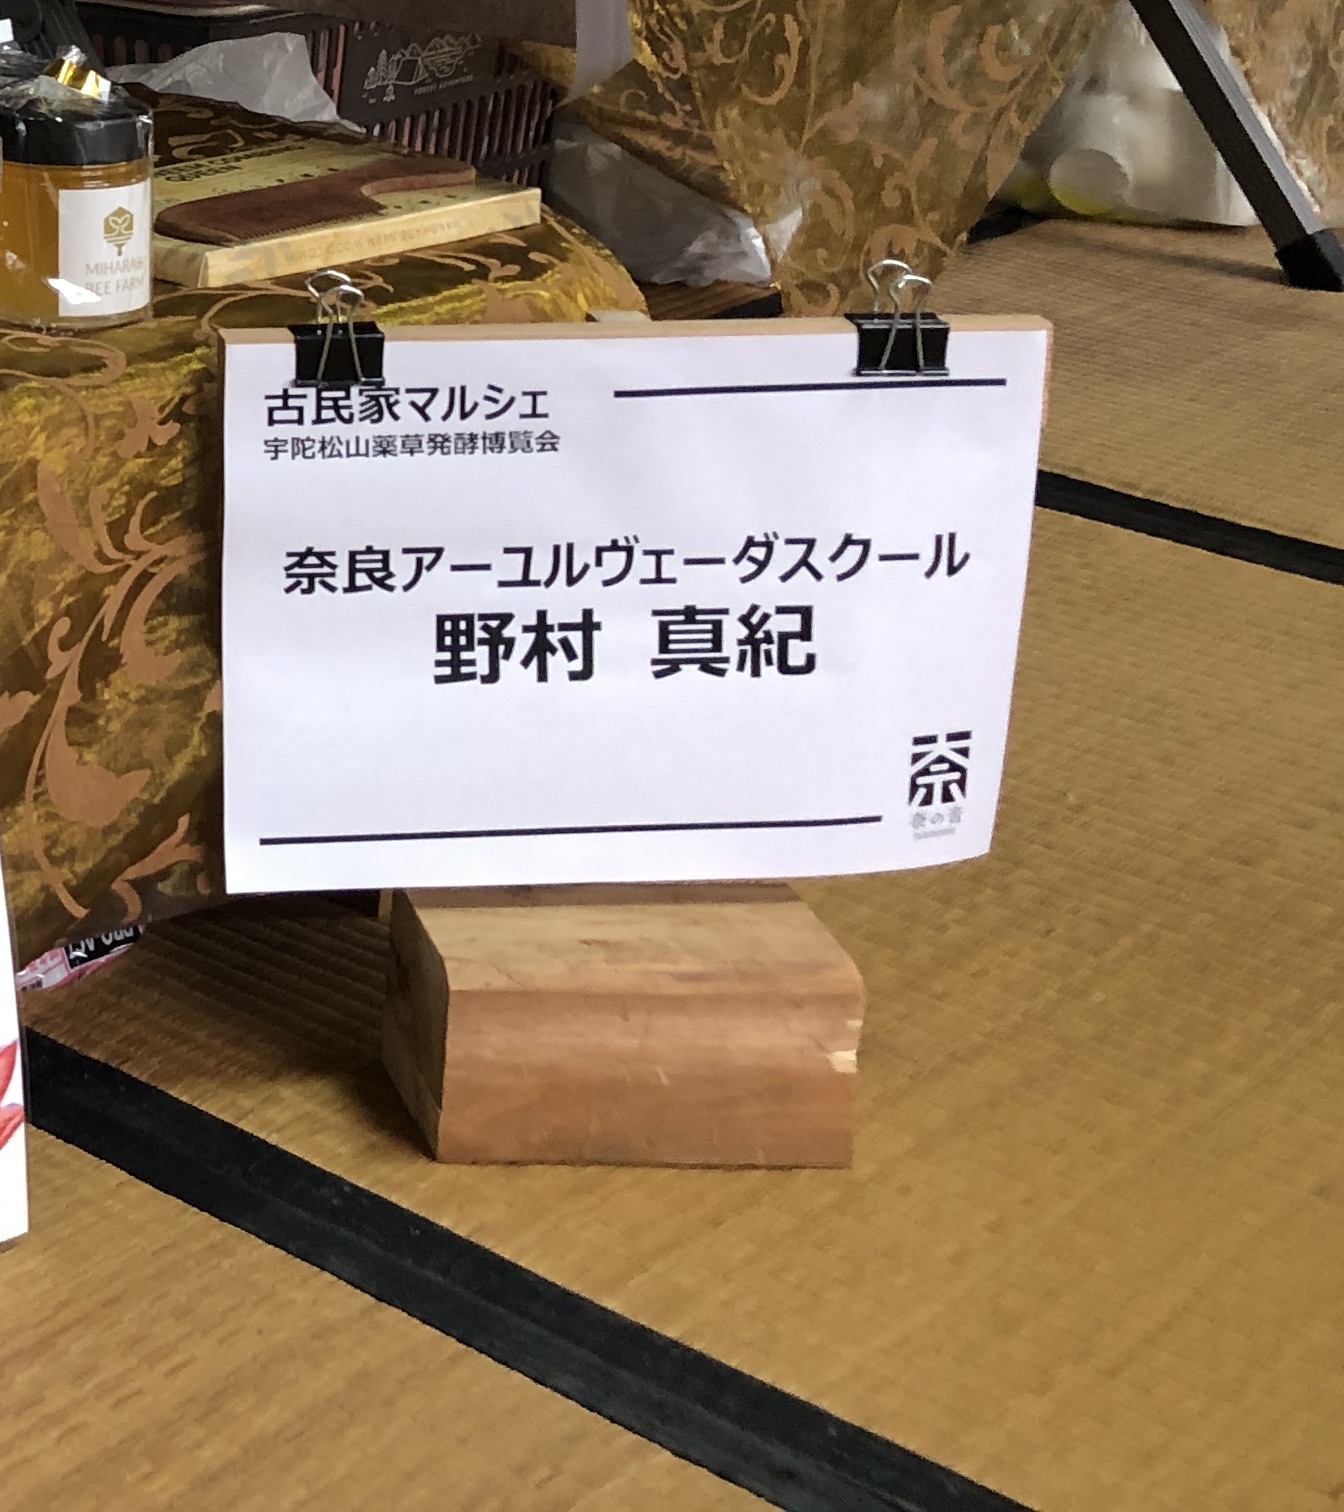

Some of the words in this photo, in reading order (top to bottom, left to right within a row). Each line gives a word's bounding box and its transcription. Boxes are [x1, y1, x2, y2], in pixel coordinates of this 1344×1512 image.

[265, 385, 551, 426] 古民家マルシェ
[264, 430, 561, 462] 宇陀松山薬草発酵博覧会
[283, 530, 972, 596] 奈良アーユルヴェーダスクール
[433, 608, 601, 686] 野村
[651, 604, 817, 679] 真紀
